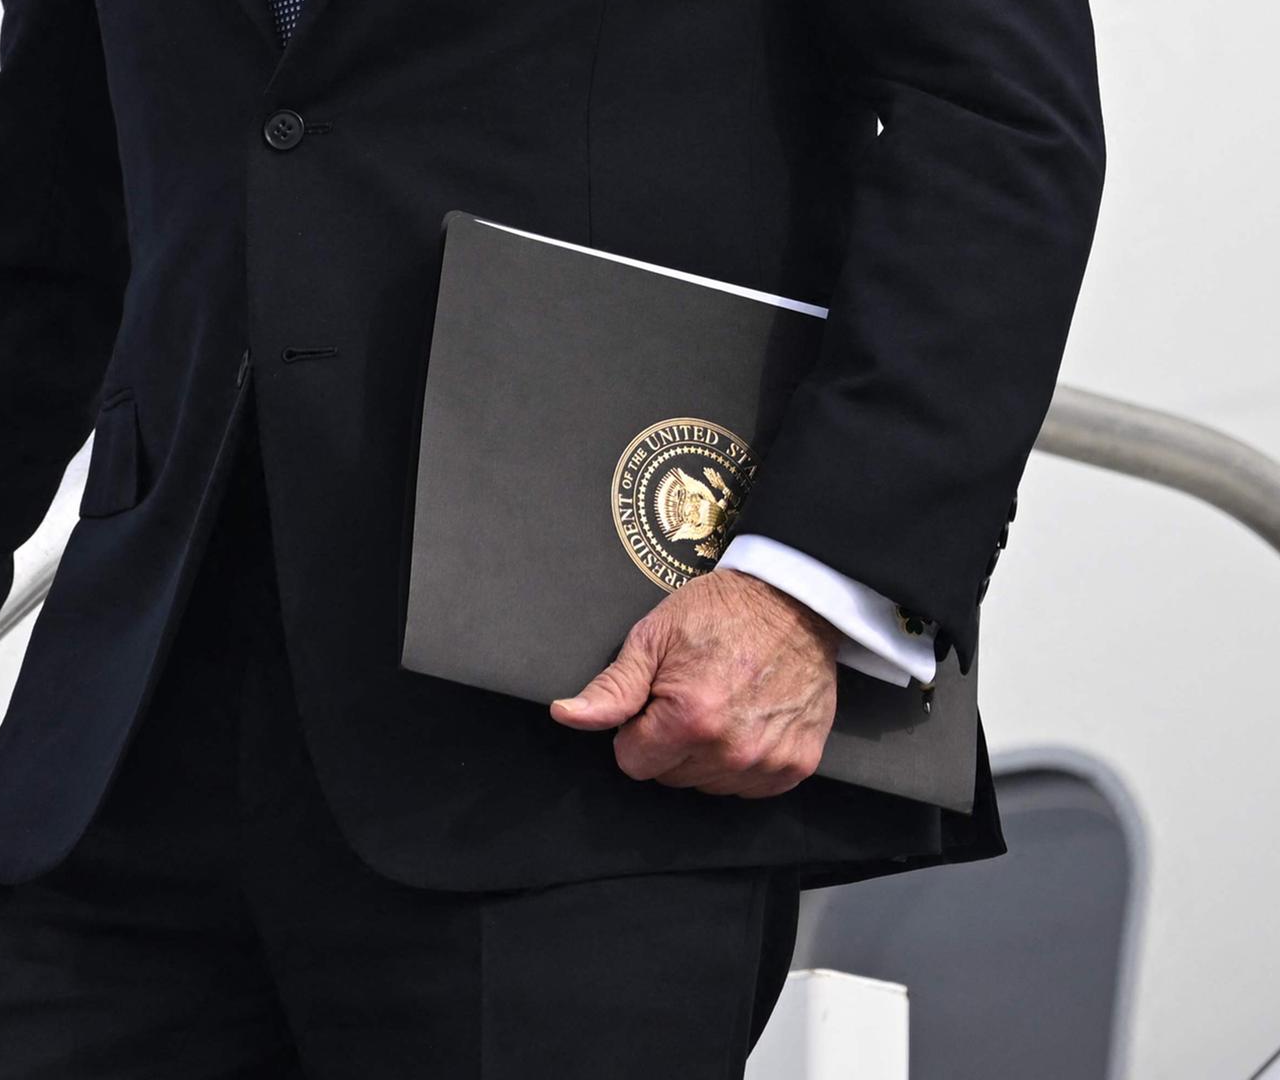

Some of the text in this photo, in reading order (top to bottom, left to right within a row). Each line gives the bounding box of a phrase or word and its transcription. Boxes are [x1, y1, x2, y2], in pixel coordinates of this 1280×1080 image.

[644, 424, 719, 450] UNITED
[627, 447, 647, 470] THE
[726, 442, 758, 481] STA
[622, 471, 633, 489] OF
